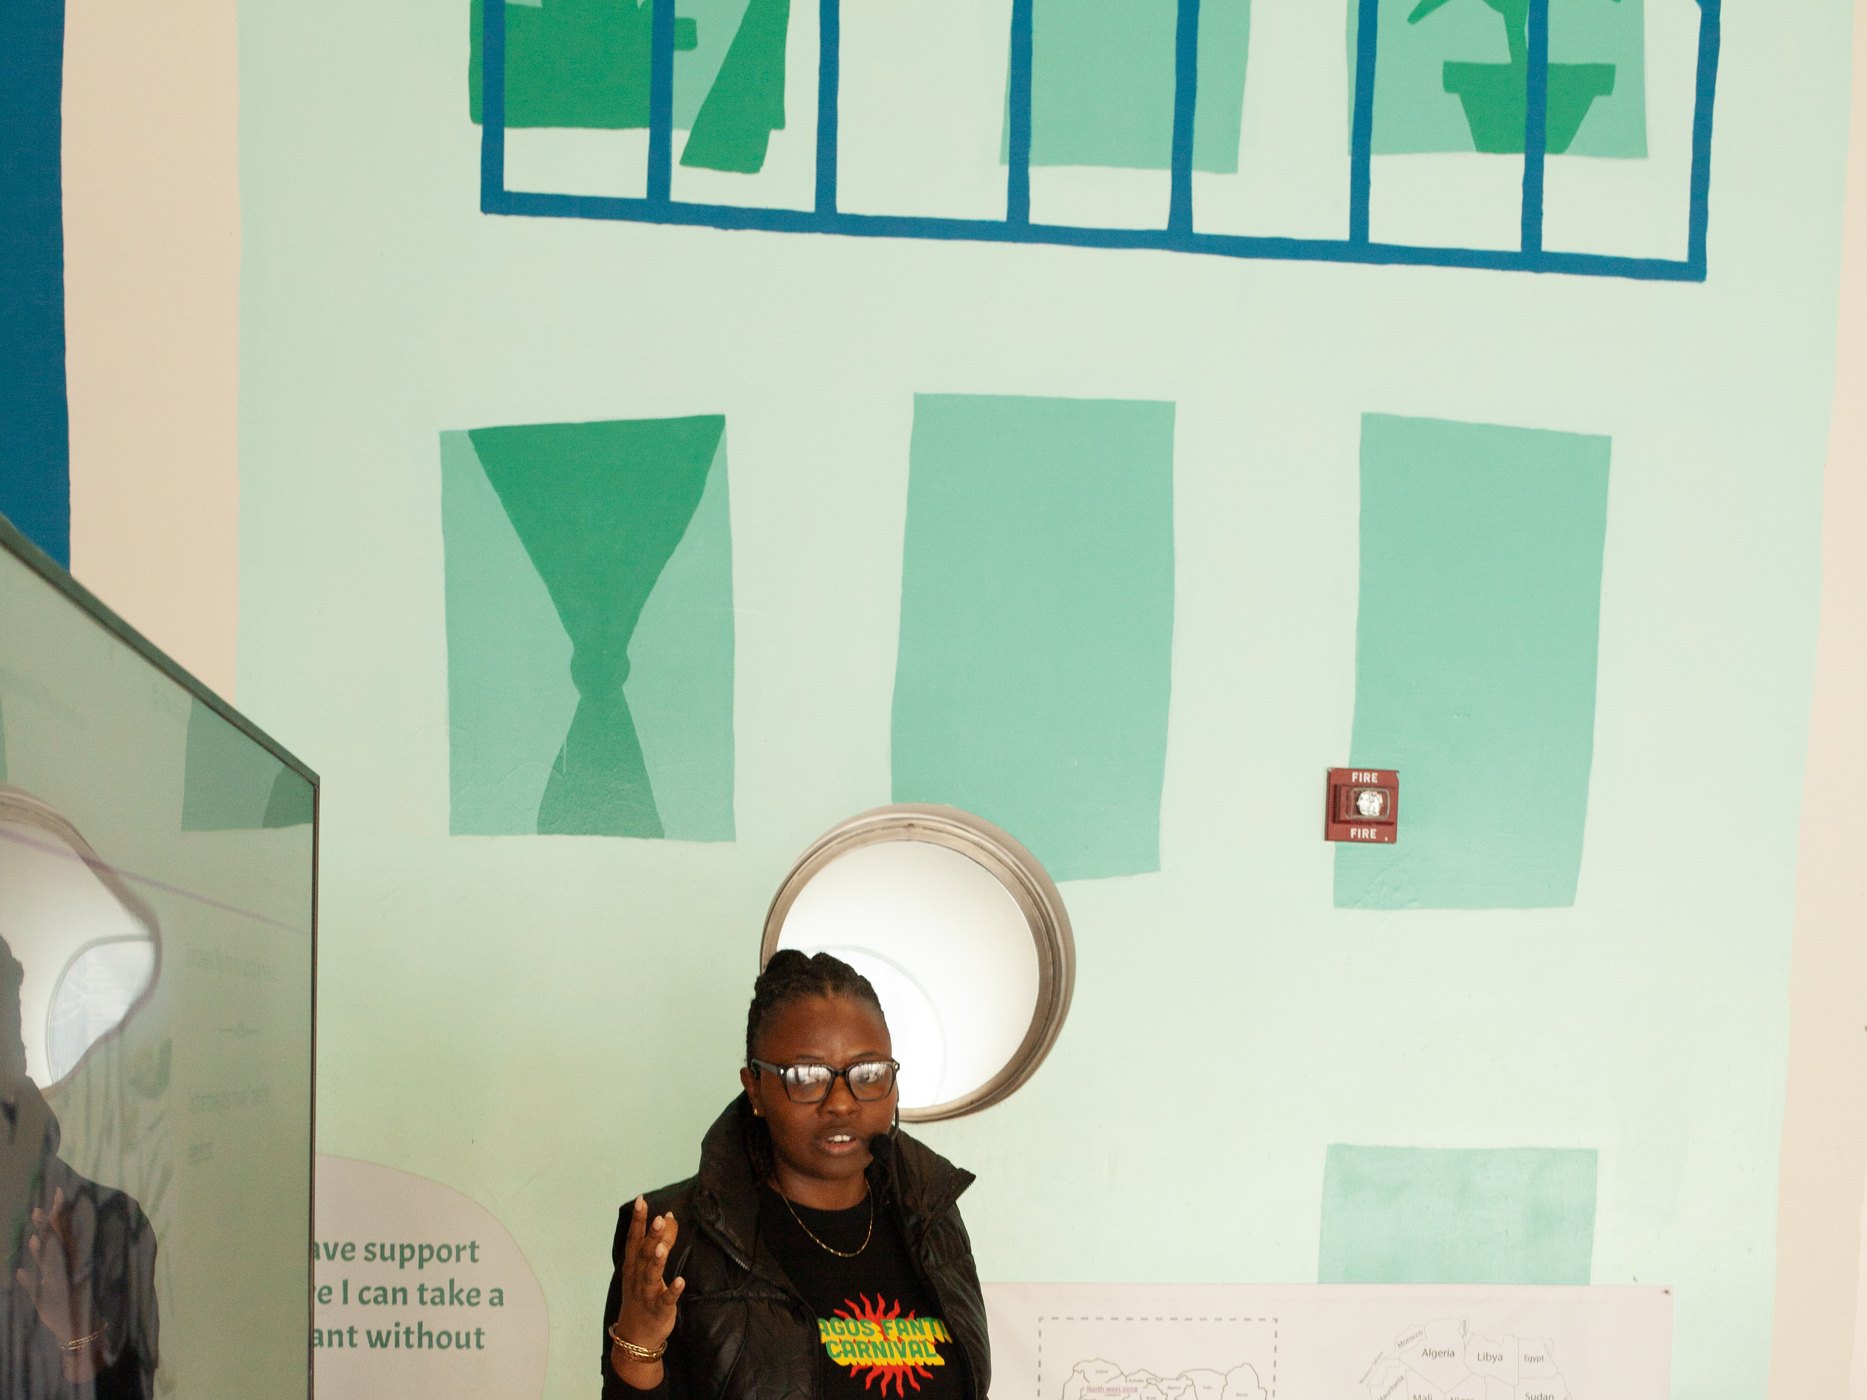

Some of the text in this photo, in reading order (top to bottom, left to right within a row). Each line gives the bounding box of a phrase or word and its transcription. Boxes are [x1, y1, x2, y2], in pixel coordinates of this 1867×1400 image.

[1351, 771, 1379, 783] FIRE
[1350, 828, 1377, 839] FIRE
[363, 1240, 480, 1270] support
[341, 1279, 349, 1305] I
[358, 1283, 408, 1306] can
[417, 1278, 481, 1307] take
[488, 1288, 505, 1307] a
[365, 1321, 486, 1350] without
[1397, 1330, 1423, 1348] Morocco
[826, 1339, 942, 1363] CARNIVAL
[1421, 1348, 1455, 1360] Algeria
[1477, 1352, 1504, 1364] Libya
[1523, 1354, 1544, 1363] Egypt
[1086, 1386, 1104, 1394] North
